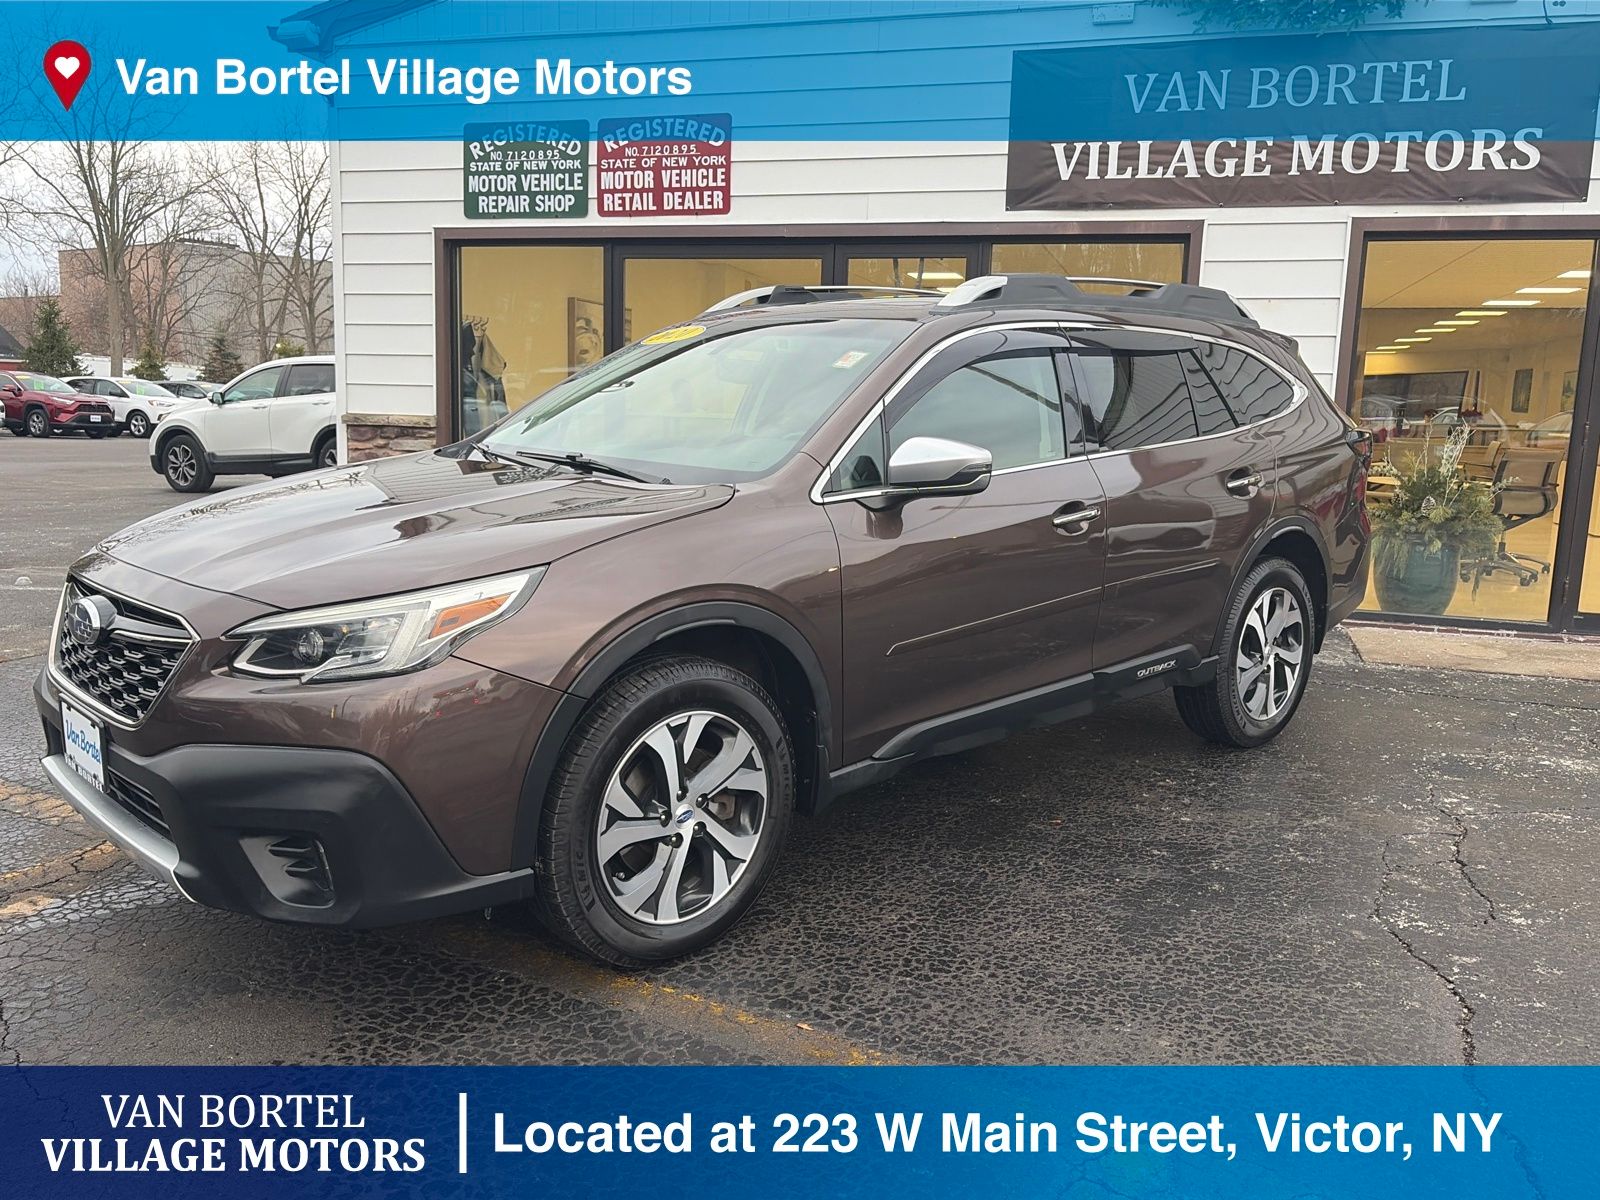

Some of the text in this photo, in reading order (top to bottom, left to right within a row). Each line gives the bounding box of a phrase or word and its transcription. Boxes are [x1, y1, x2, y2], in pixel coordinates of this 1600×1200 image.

[1124, 59, 1467, 114] VAN BORTEL
[469, 123, 581, 160] REGISTERED
[602, 118, 726, 153] REGISTERED
[490, 149, 560, 161] NO. 7120895
[625, 144, 697, 157] NO. 7120895
[1051, 128, 1544, 181] VILLAGE MOTORS
[469, 159, 582, 172] STATE OF NEW YORK
[600, 155, 727, 169] STATE OF NEW YORK
[468, 173, 584, 193] MOTOR VEHICLE
[600, 168, 726, 190] MOTOR VEHICLE
[478, 194, 575, 213] REPAIR SHOP
[603, 190, 724, 212] RETAIL DEALER
[1136, 660, 1177, 678] OUTBACK
[65, 719, 80, 748] Van
